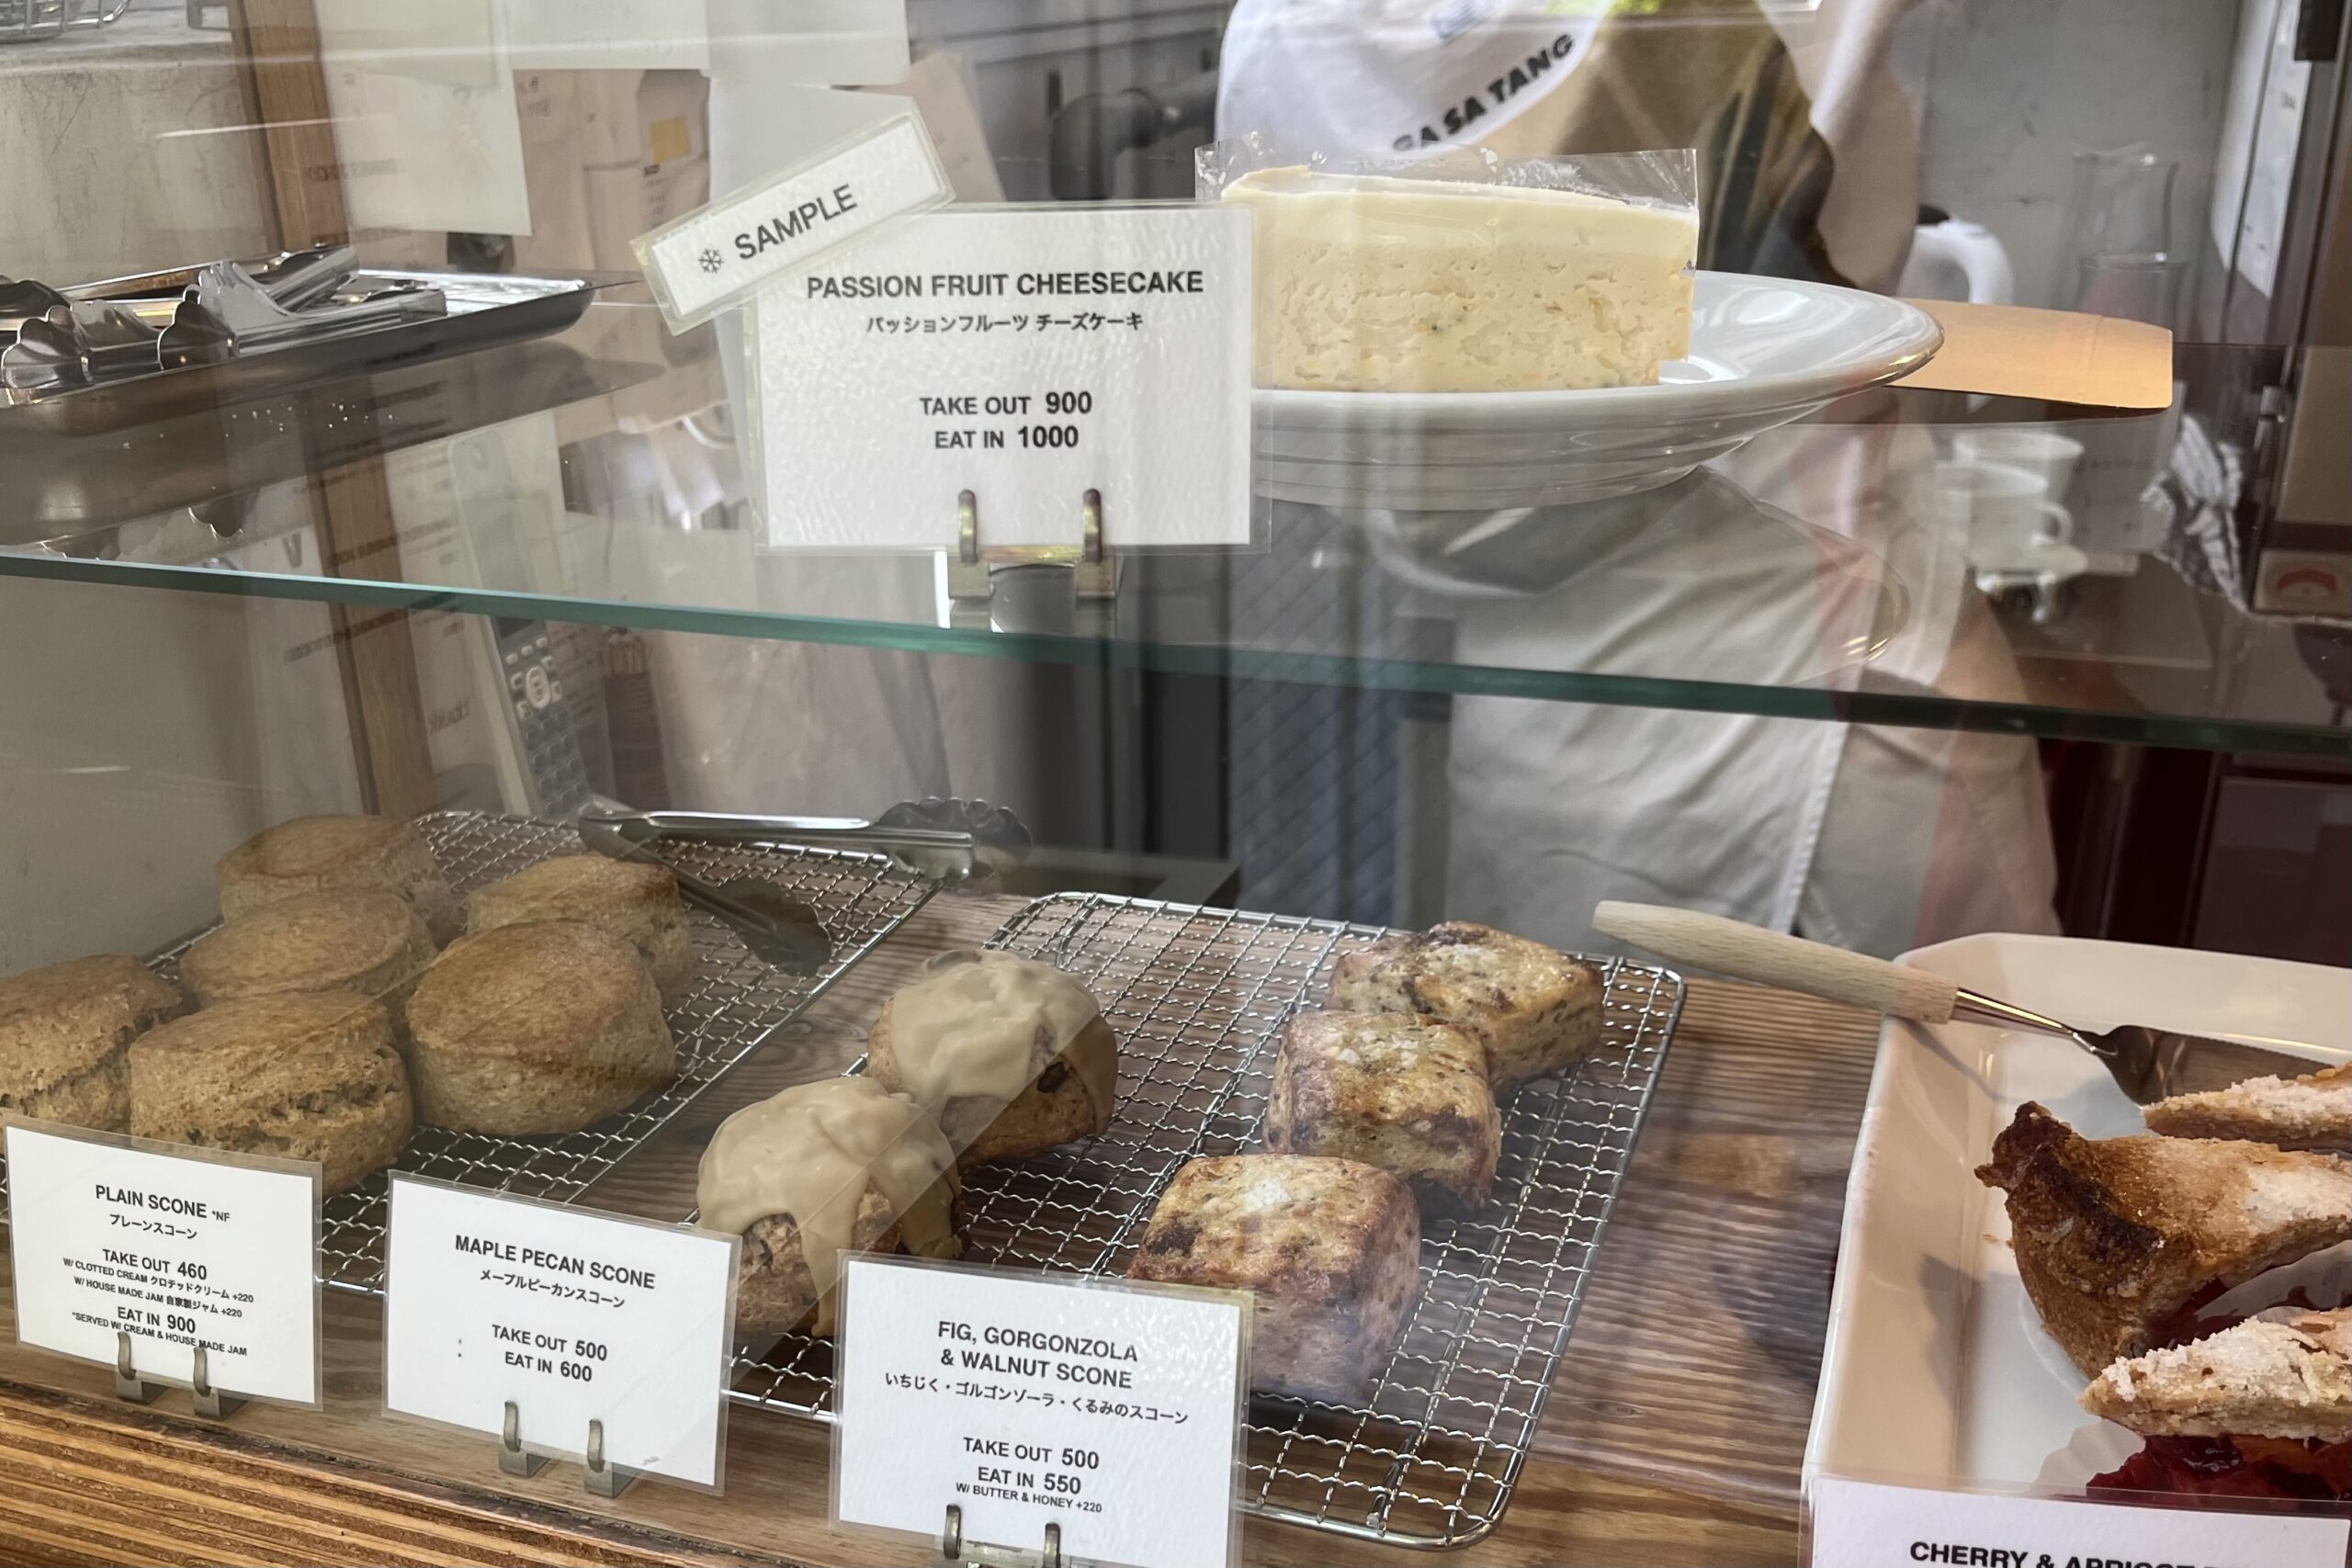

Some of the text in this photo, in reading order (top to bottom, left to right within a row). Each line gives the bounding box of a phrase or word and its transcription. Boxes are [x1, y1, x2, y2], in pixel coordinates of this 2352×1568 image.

[734, 184, 858, 260] SAMPLE
[808, 271, 1204, 299] PASSION FRUIT CHEESECAKE
[866, 311, 1144, 334] パッションフルーツ チーズケーキ
[920, 391, 1093, 415] TAKE OUT 900
[935, 425, 1080, 449] EAT IN 1000
[96, 1184, 143, 1207] PLAIN
[148, 1194, 207, 1218] SCONE
[109, 1213, 198, 1239] プレーンスコーン
[102, 1248, 208, 1280] TAKE OUT 460
[455, 1235, 656, 1290] MAPLE PECAN SCONE
[62, 1258, 254, 1303] W/ CLOTTED CREAM クロテッドクリーム +220
[74, 1276, 85, 1286] W/
[85, 1280, 117, 1293] HOUSE
[118, 1286, 144, 1299] MADE
[145, 1292, 164, 1303] JAM
[221, 1307, 243, 1318] +220
[118, 1306, 196, 1334] EAT IN 900
[110, 1320, 122, 1330] W/
[123, 1323, 155, 1337] CREAM
[157, 1331, 164, 1340] &
[165, 1333, 197, 1347] HOUSE
[198, 1339, 225, 1353] MADE
[228, 1346, 247, 1357] JAM
[492, 1325, 607, 1361] TAKE OUT 500
[938, 1321, 1138, 1362] FIG, GORGONZOLA
[505, 1351, 593, 1382] EAT IN 600
[941, 1349, 1133, 1389] & WALNUT SCONE
[963, 1437, 1099, 1470] TAKE OUT 500
[978, 1466, 1081, 1495] EAT IN 550
[956, 1483, 1102, 1514] W/ BUTTER & HONEY +220
[1910, 1541, 2028, 1568] CHERRY
